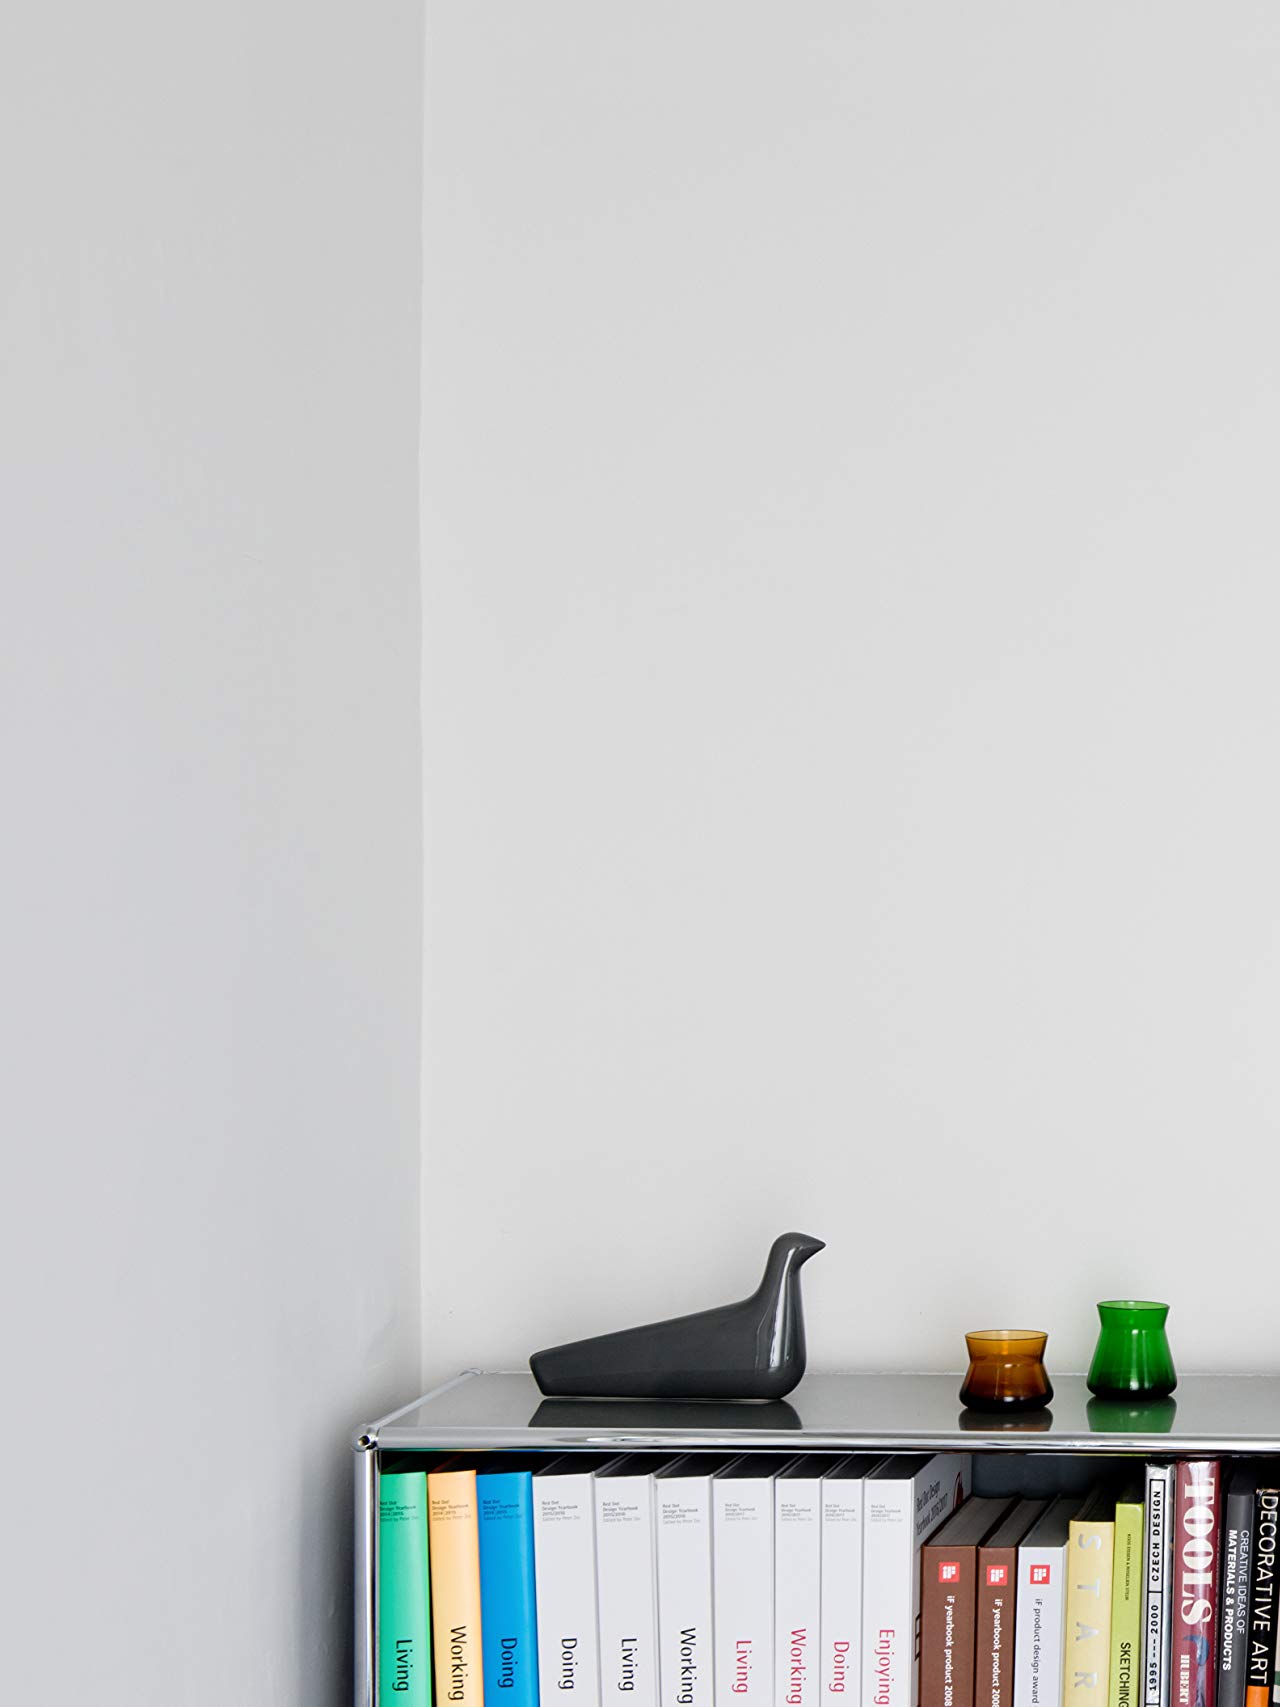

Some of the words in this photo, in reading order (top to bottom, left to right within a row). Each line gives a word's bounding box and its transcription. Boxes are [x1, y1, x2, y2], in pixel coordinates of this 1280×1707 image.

[1153, 1491, 1161, 1536] DESIGN
[1152, 1541, 1160, 1582] CZECH
[1181, 1477, 1216, 1625] TOOLS
[1226, 1529, 1238, 1596] MATERIALS
[1238, 1530, 1250, 1585] CREATIVE
[1253, 1492, 1278, 1632] DECORATIVE
[947, 1595, 955, 1604] iF
[995, 1598, 1003, 1607] iF
[1151, 1604, 1159, 1635] 2000
[1226, 1597, 1234, 1605] &
[1237, 1585, 1247, 1618] IDEAS
[945, 1605, 955, 1647] yearbook
[993, 1608, 1002, 1650] yearbook
[1033, 1608, 1042, 1642] product
[1222, 1608, 1234, 1671] PRODUCTS
[1236, 1619, 1246, 1635] OF
[392, 1639, 412, 1691] Living
[448, 1626, 468, 1700] Working
[498, 1638, 517, 1688] Doing
[558, 1638, 578, 1690] Doing
[618, 1638, 638, 1691] Living
[677, 1628, 697, 1704] Working
[732, 1640, 752, 1693] Living
[786, 1629, 807, 1704] Working
[829, 1641, 850, 1692] Doing
[874, 1629, 895, 1705] Enjoying
[944, 1649, 953, 1683] product
[992, 1652, 1001, 1687] product
[1031, 1644, 1041, 1673] design
[1118, 1642, 1131, 1707] SKETCHING
[1149, 1662, 1158, 1692] 1995
[1249, 1641, 1269, 1684] ART
[944, 1685, 953, 1707] 2008
[1032, 1676, 1040, 1704] award
